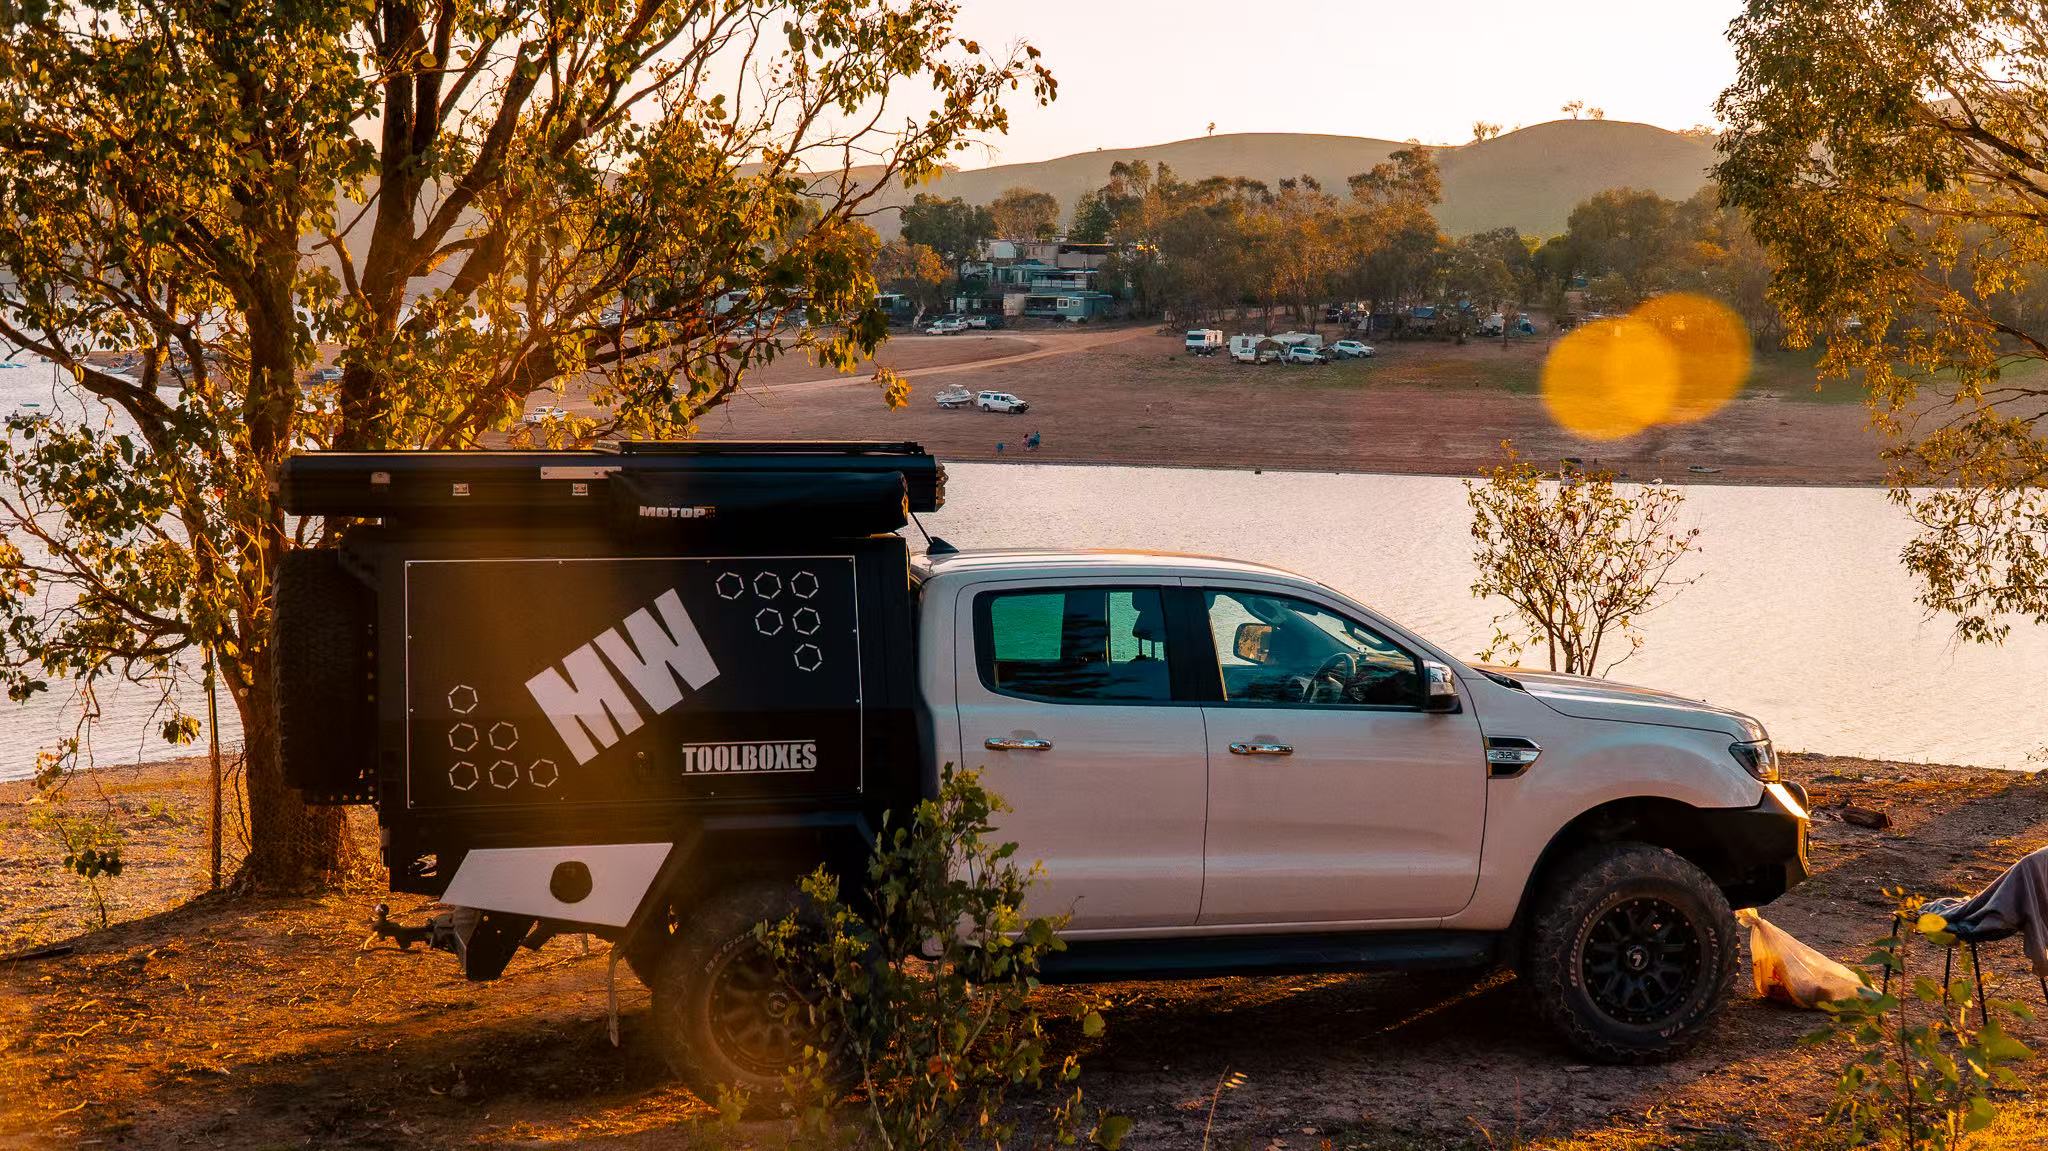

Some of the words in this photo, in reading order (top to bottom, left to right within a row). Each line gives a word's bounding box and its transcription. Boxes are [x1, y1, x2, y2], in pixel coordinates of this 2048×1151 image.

[639, 505, 706, 518] MOTOP
[525, 588, 720, 766] MW
[682, 743, 817, 772] TOOLBOXES
